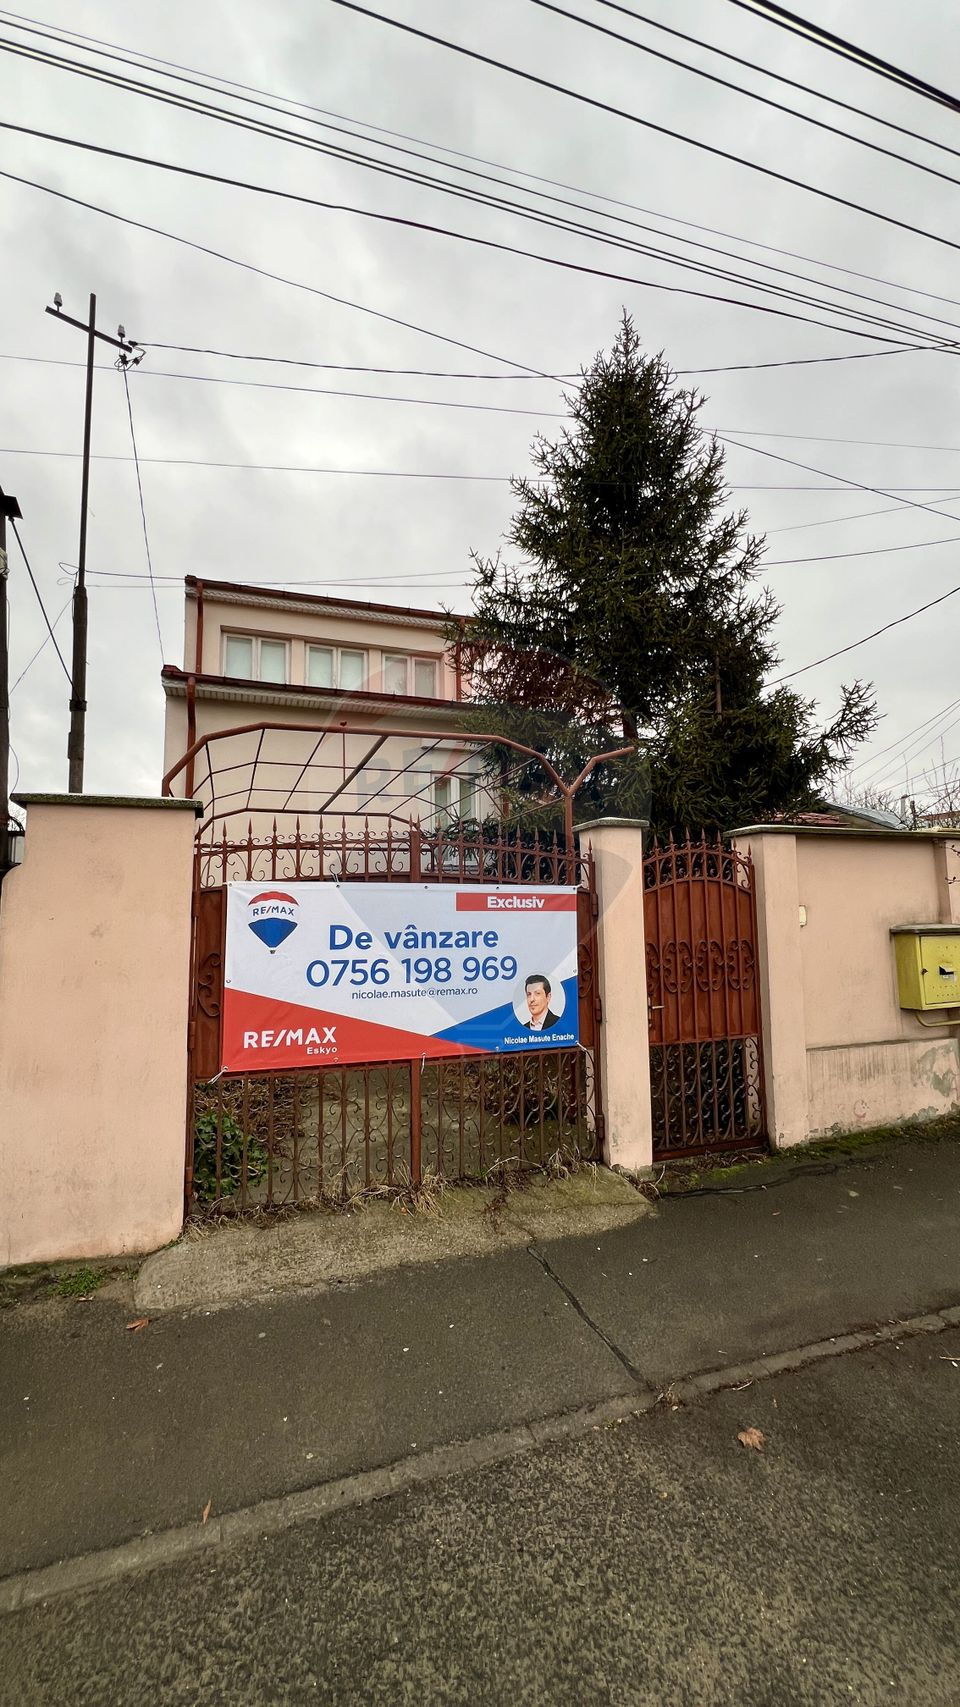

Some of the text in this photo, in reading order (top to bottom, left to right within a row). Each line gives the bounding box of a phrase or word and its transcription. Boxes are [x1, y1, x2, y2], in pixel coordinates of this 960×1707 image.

[487, 896, 545, 909] Exclusiv
[252, 905, 295, 917] RE/MAX
[329, 924, 499, 950] De vânzare
[306, 955, 518, 987] 0756 198 969
[351, 986, 478, 1000] nicolae.masute@remax.ro
[243, 1026, 337, 1049] RE/MAX
[504, 1033, 575, 1045] Nicolae Masute Enache
[306, 1046, 338, 1055] Eskyo
